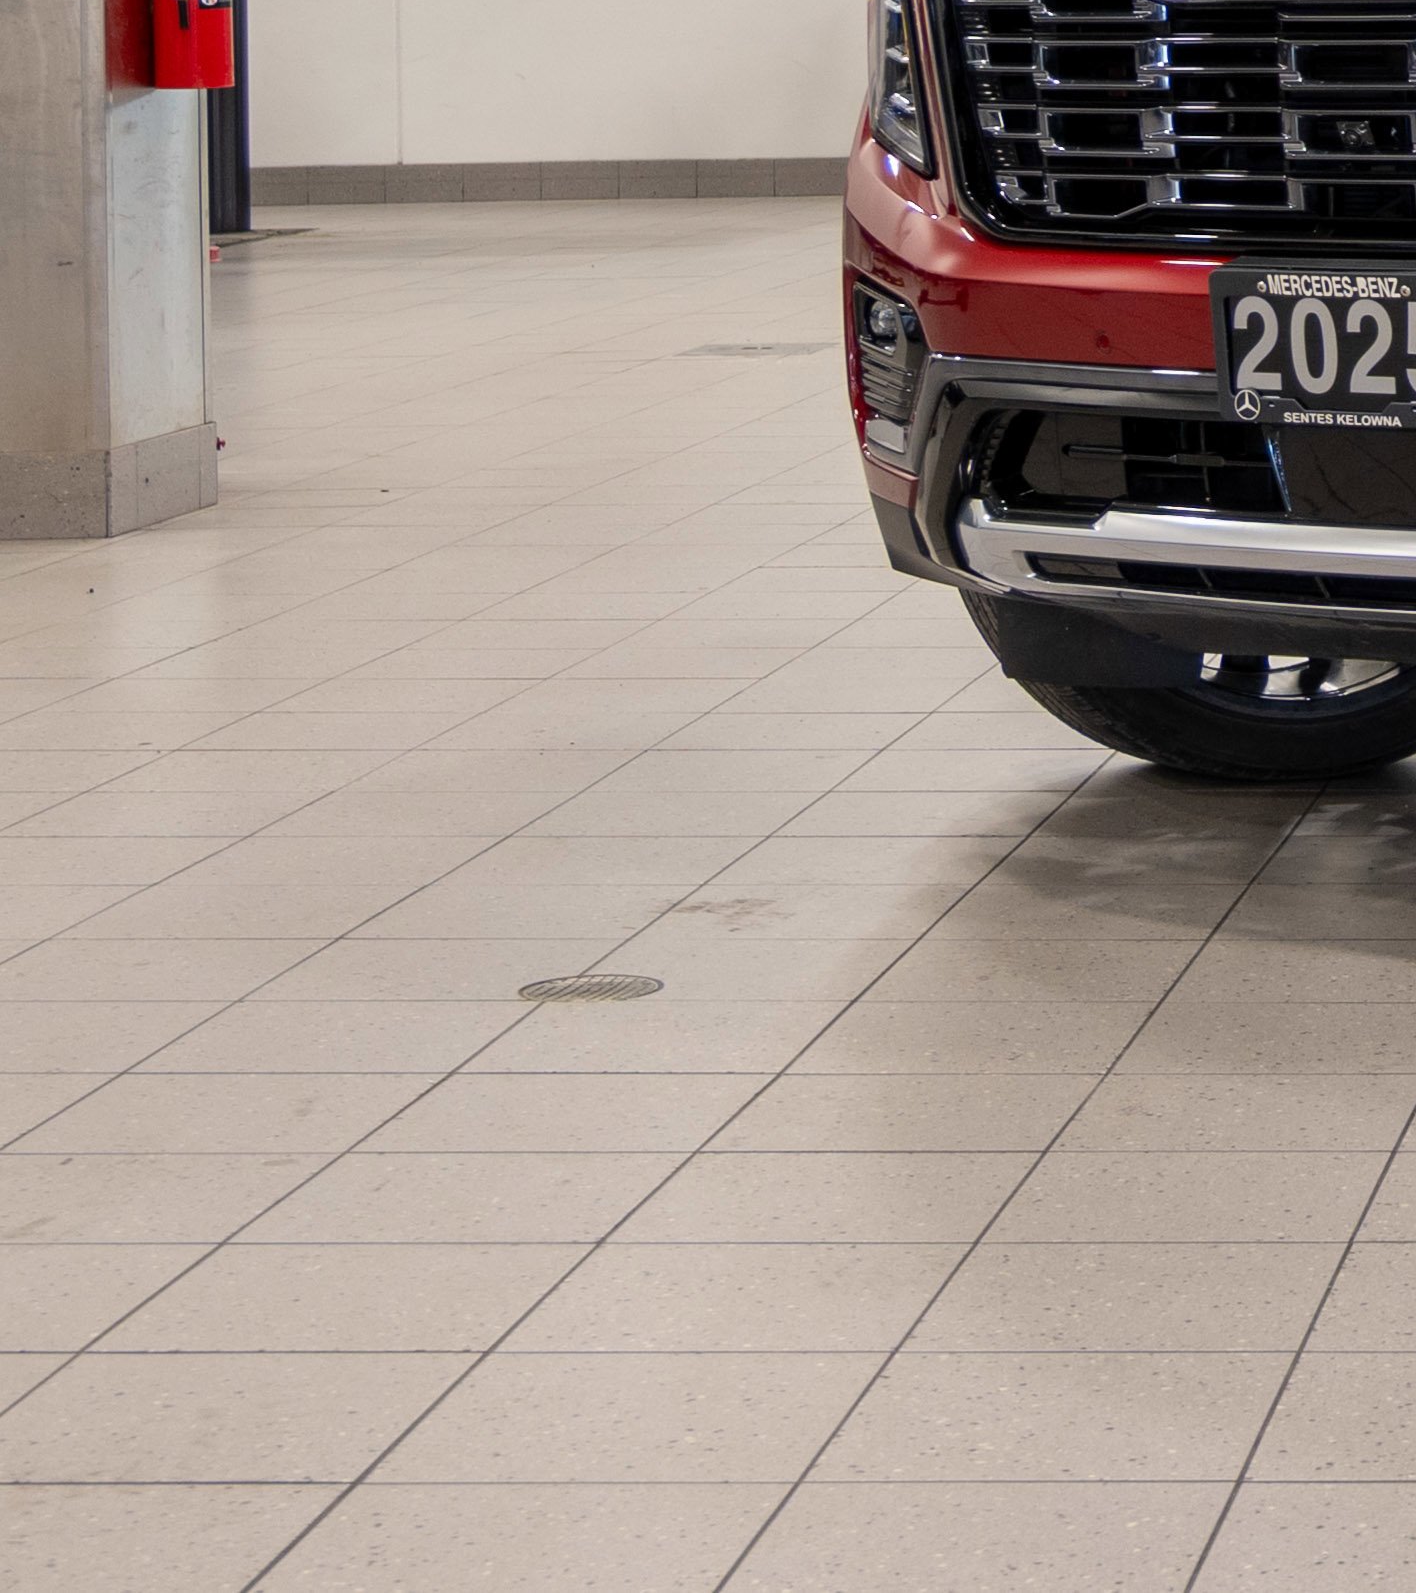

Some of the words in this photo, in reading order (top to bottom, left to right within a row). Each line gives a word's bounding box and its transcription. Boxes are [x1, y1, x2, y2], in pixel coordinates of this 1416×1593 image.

[1266, 274, 1402, 298] MERCEDES-BENZ
[1283, 411, 1334, 425] SENTES
[1336, 413, 1402, 428] KELOWNA
